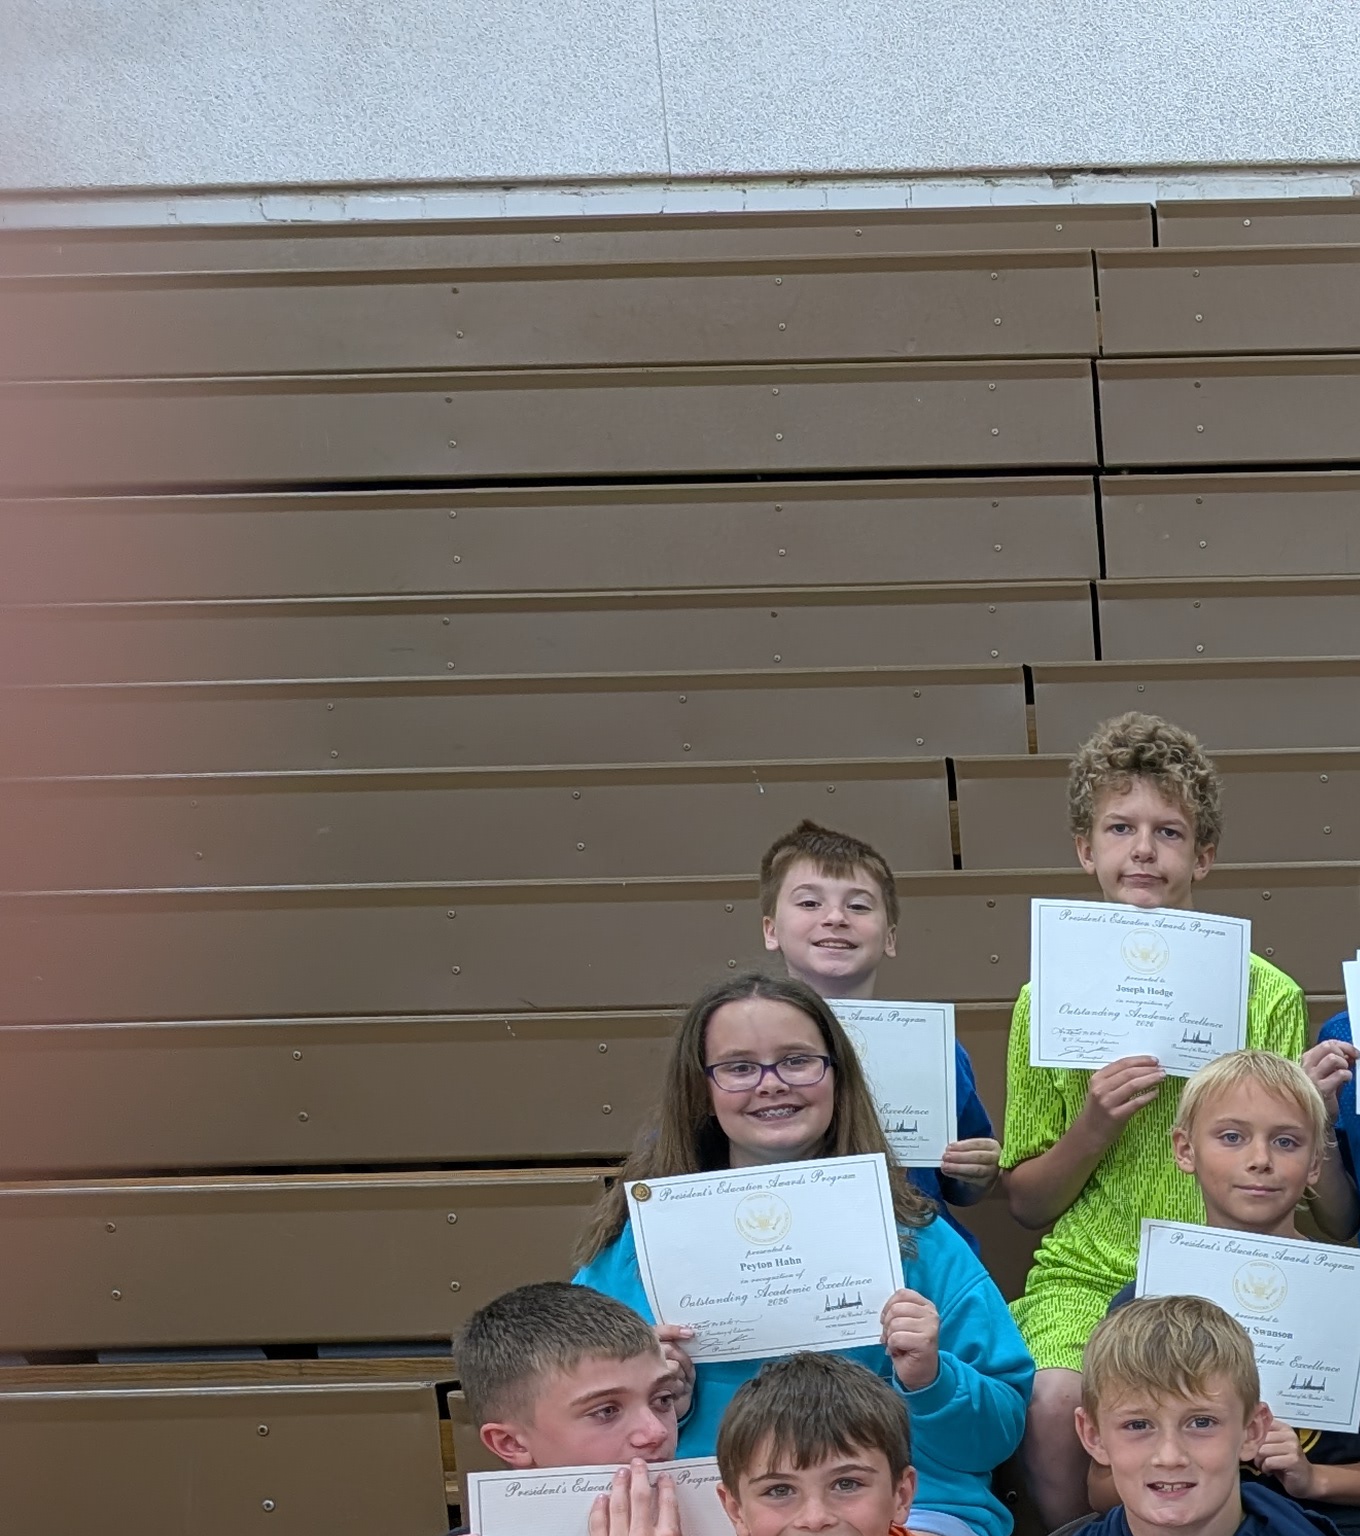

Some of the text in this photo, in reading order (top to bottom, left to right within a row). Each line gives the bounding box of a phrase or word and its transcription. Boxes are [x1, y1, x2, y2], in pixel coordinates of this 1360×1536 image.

[1058, 908, 1226, 938] President's Education Awards Program
[1115, 984, 1173, 997] Joseph Hodge
[848, 1010, 926, 1026] Awards Program
[880, 1103, 929, 1116] Excellence
[658, 1168, 856, 1202] President's Education Awards Program
[739, 1256, 801, 1272] Peyton Hahn
[1252, 1326, 1292, 1339] Swanson
[504, 1480, 568, 1498] President's
